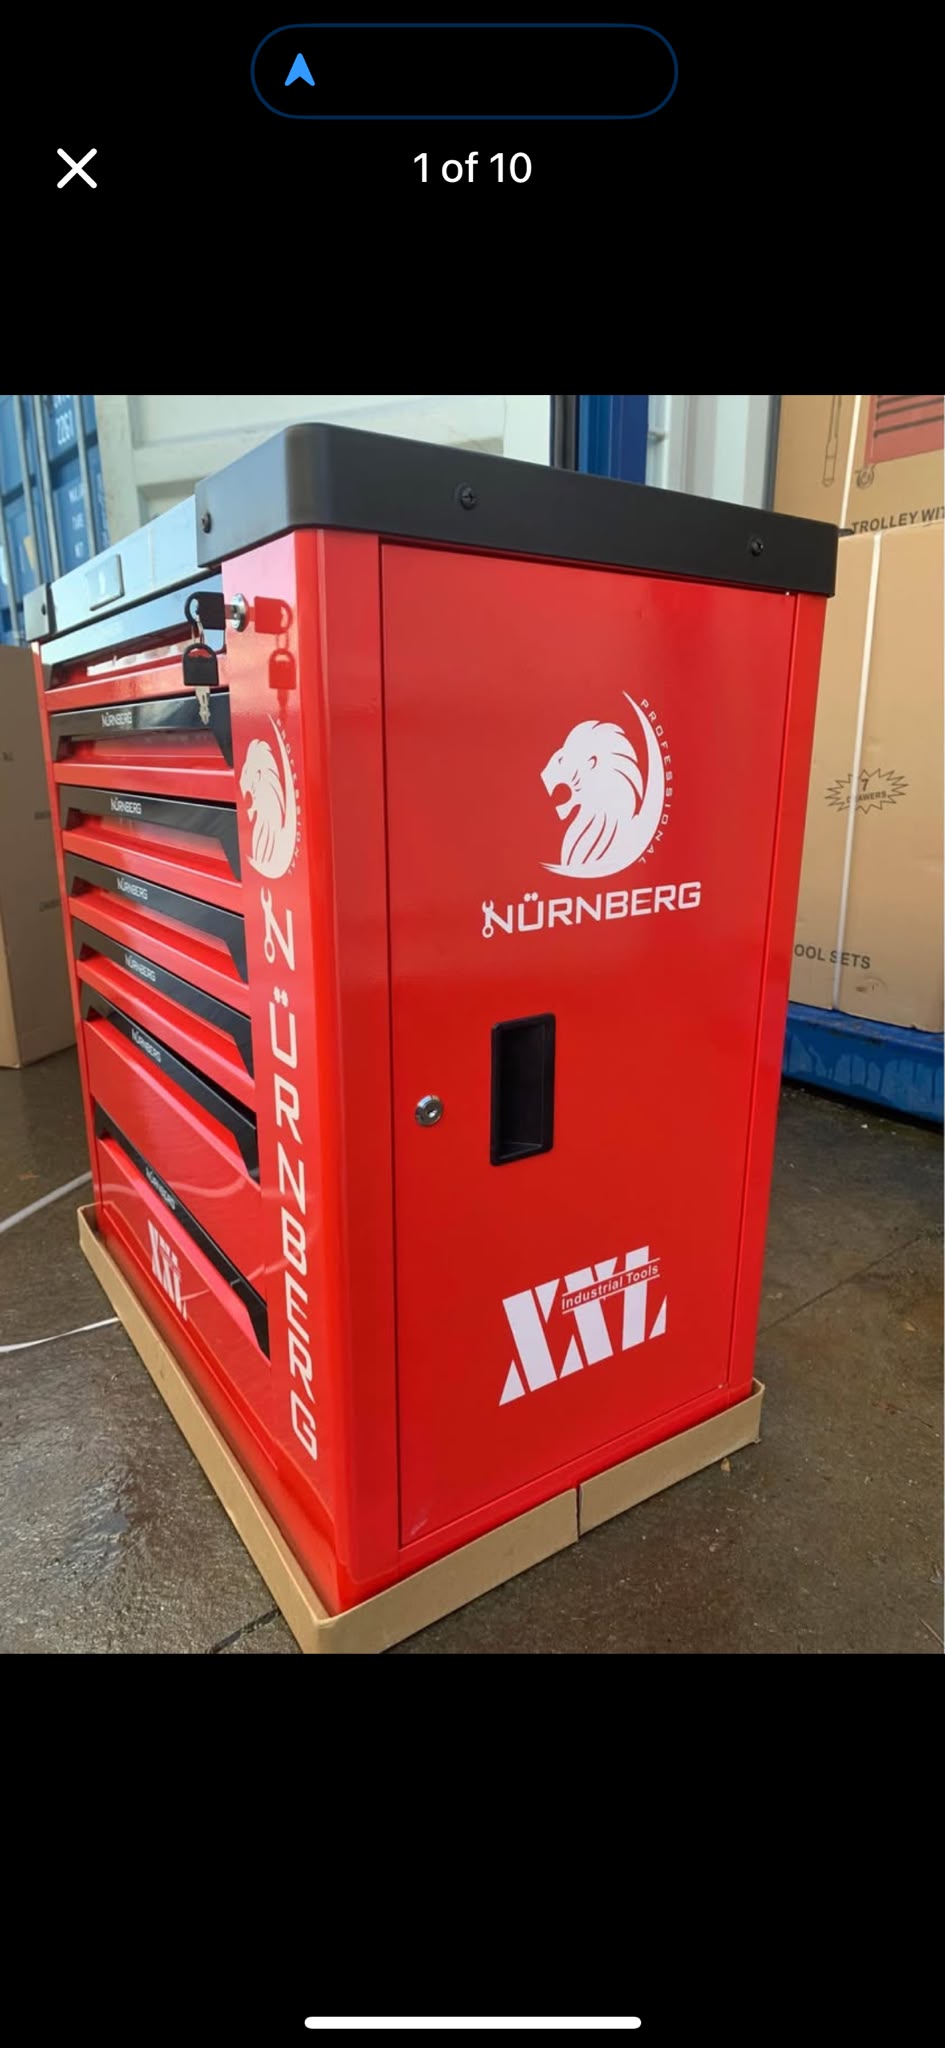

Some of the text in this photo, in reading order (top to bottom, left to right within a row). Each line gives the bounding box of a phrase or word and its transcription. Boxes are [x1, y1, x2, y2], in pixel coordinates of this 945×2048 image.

[852, 511, 918, 534] TROLLEY
[640, 699, 673, 864] PROFESSIONAL
[861, 778, 869, 792] 7
[482, 880, 702, 938] NÜRNBERG
[794, 943, 871, 970] OOL SETS
[260, 887, 318, 1460] NÜRNBERG
[147, 1219, 188, 1321] XXL
[561, 1264, 659, 1311] Industrial Tools
[499, 1245, 668, 1407] XXL
